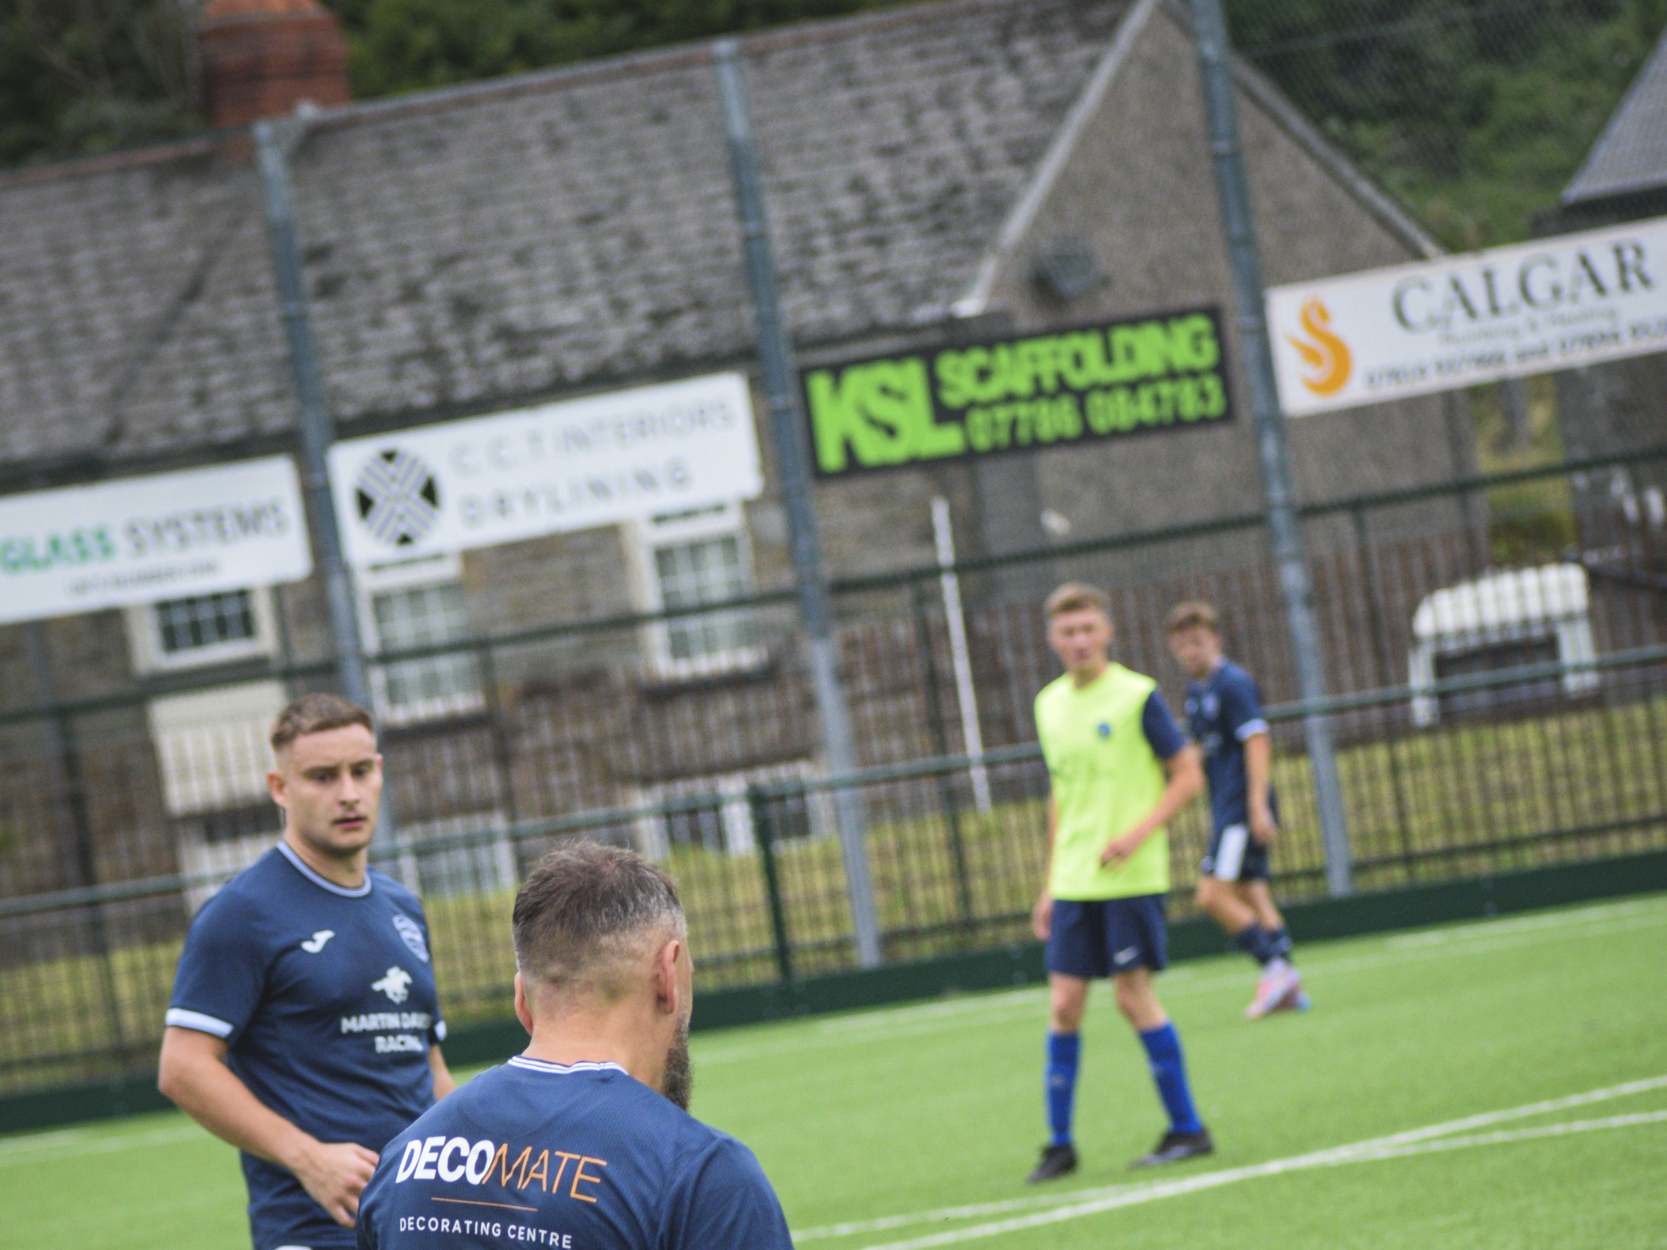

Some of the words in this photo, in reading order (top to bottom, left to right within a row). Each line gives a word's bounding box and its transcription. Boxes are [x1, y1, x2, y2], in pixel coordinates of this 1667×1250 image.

[1391, 238, 1655, 334] CALGAR
[934, 312, 1220, 410] SCAFFOLDING
[805, 356, 968, 474] KSL
[457, 455, 694, 529] DRYLINING
[123, 500, 286, 557] SYSTEMS
[340, 1012, 399, 1034] MARTIN
[395, 1135, 608, 1204] DECOMATE
[399, 1216, 502, 1238] DECORATING
[507, 1224, 573, 1250] CENTRE
